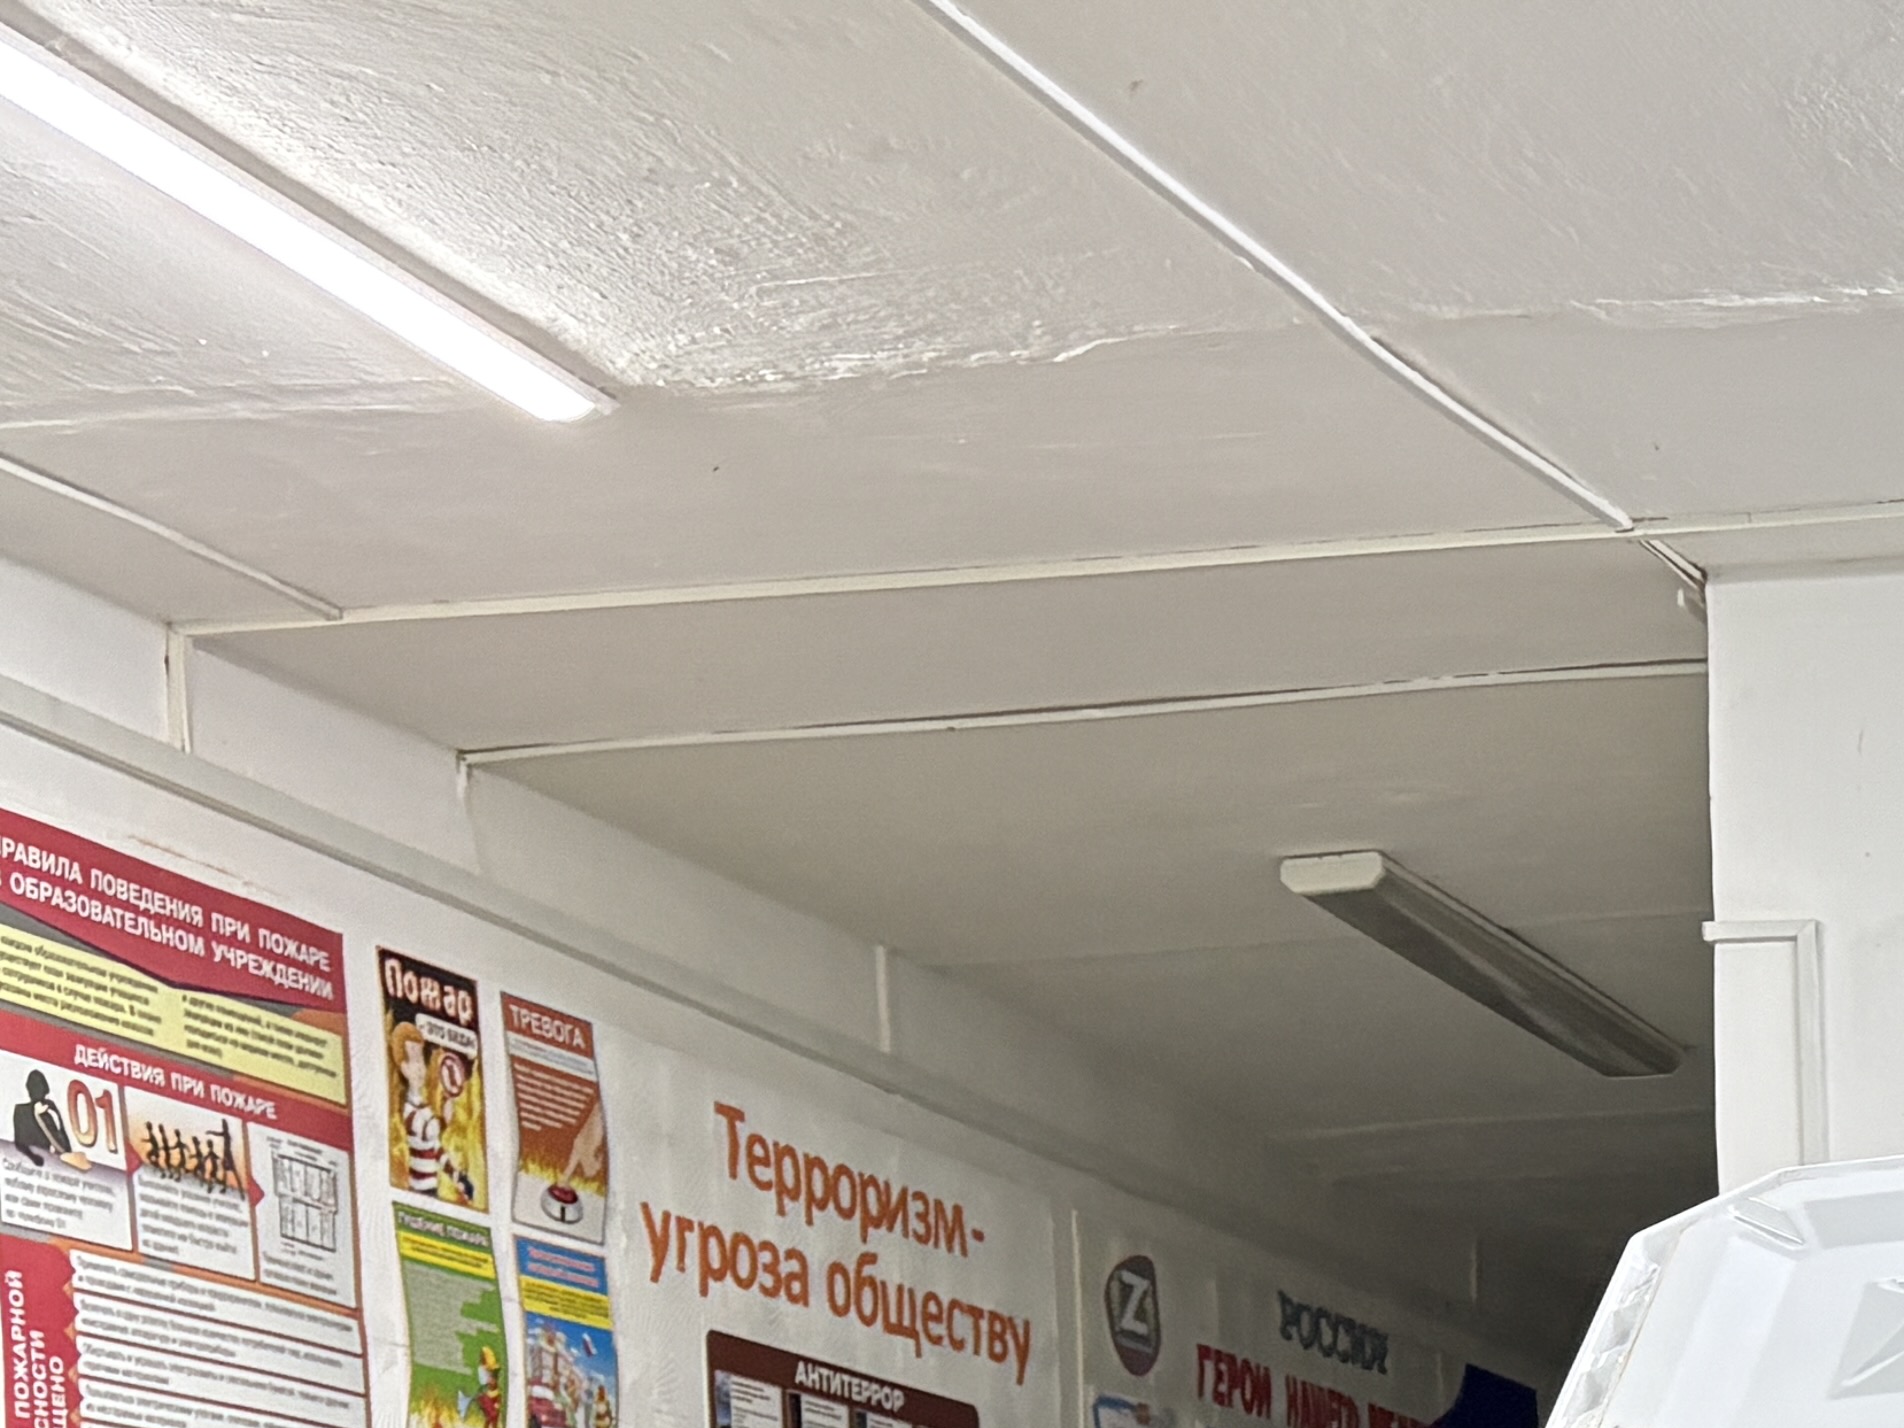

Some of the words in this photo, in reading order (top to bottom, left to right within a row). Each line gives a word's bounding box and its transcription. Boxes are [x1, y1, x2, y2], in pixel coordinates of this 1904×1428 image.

[10, 872, 205, 956] ОБРАЗОВАТЕЛЬНОМ
[211, 943, 334, 1000] УЧРЕЖДЕНИИ
[90, 868, 203, 928] ПОВЕДЕНИЯ
[210, 912, 251, 945] ПРИ
[258, 927, 331, 973] ПОЖАРЕ
[509, 1003, 586, 1050] ТРЕВОГА
[67, 1079, 119, 1155] 01
[74, 1043, 165, 1088] ДЕЙСТВИЯ
[171, 1070, 204, 1098] ПРИ
[210, 1083, 277, 1120] ПОЖАРЕ
[640, 1201, 810, 1309] угроза
[826, 1251, 1031, 1386] обществу
[5, 1270, 29, 1422] ПОЖАРНОЙ
[1196, 1343, 1272, 1419] ГЕРОИ
[795, 1360, 906, 1413] АНТИТЕРРОР
